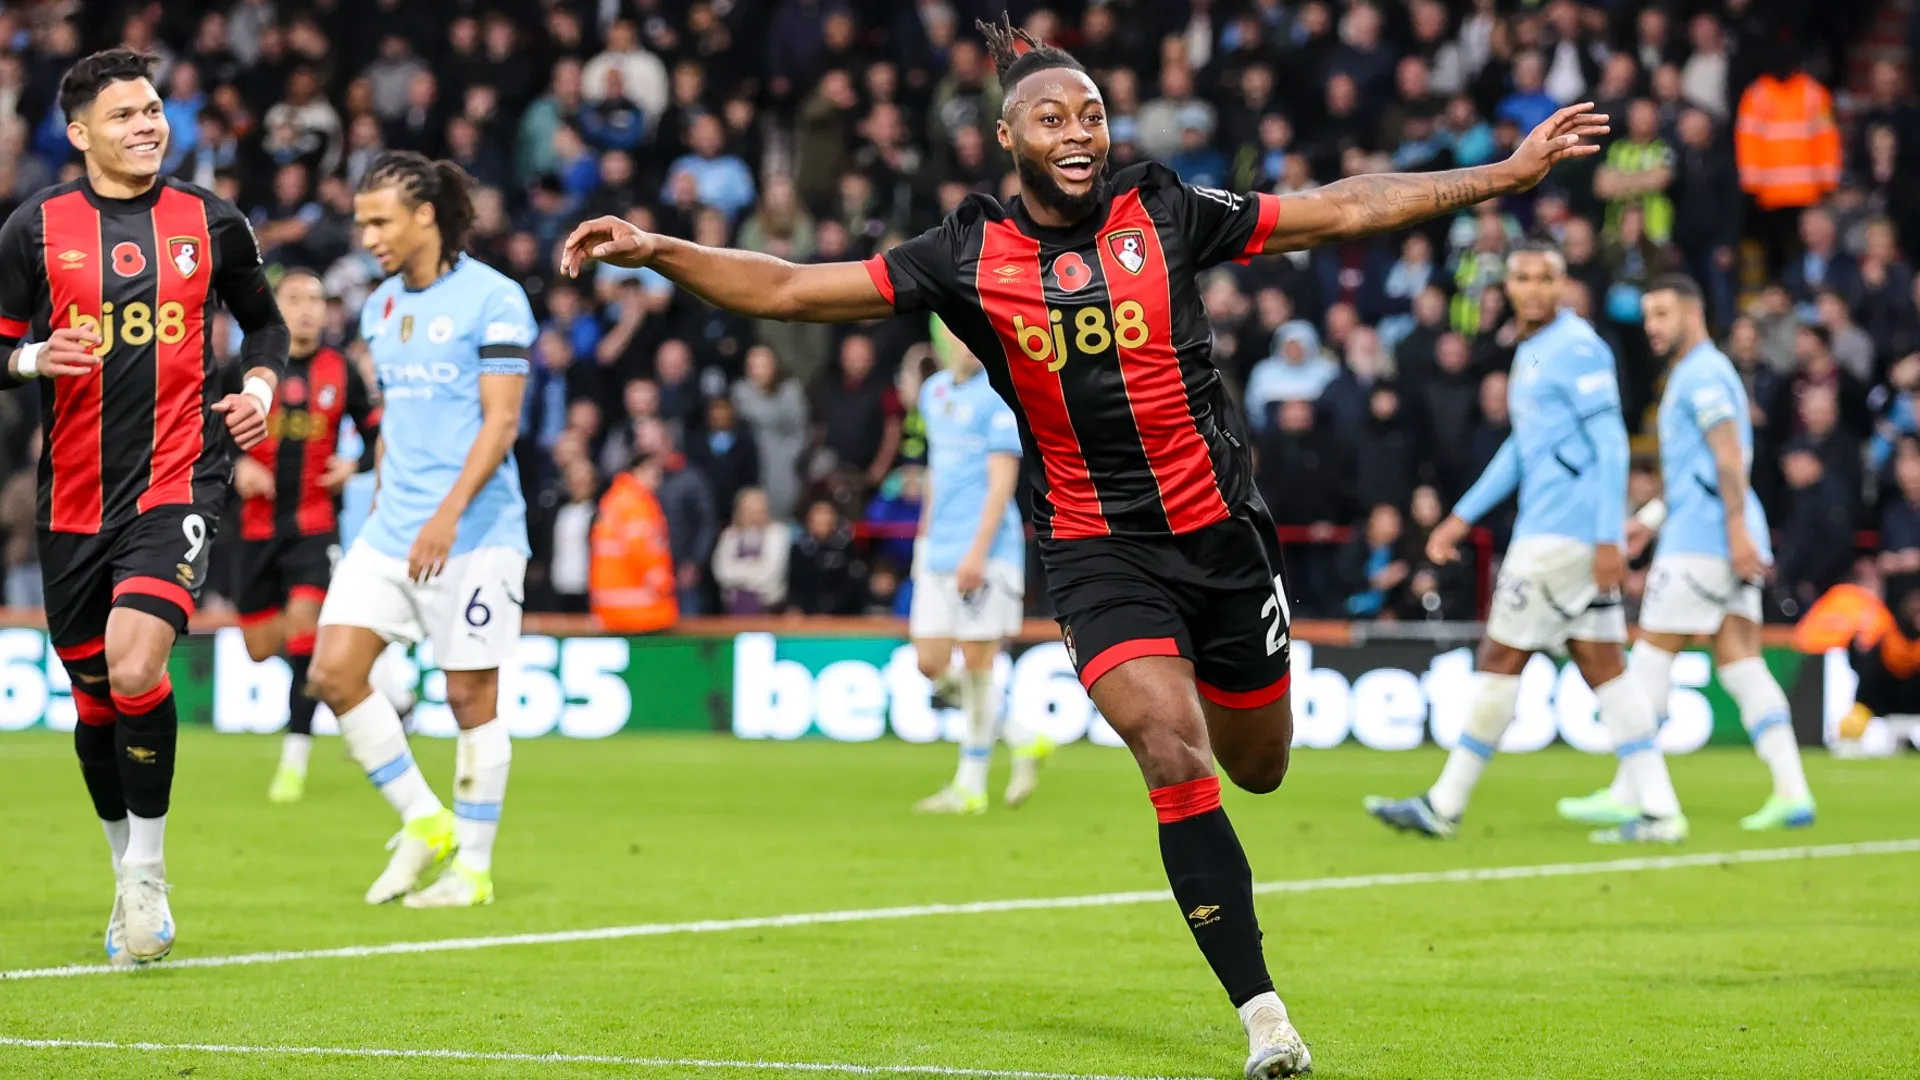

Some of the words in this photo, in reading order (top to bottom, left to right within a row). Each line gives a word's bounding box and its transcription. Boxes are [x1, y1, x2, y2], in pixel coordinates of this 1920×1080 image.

[68, 301, 186, 357] bj88
[1012, 300, 1149, 372] bj88
[182, 513, 206, 562] 9
[465, 587, 490, 627] 6
